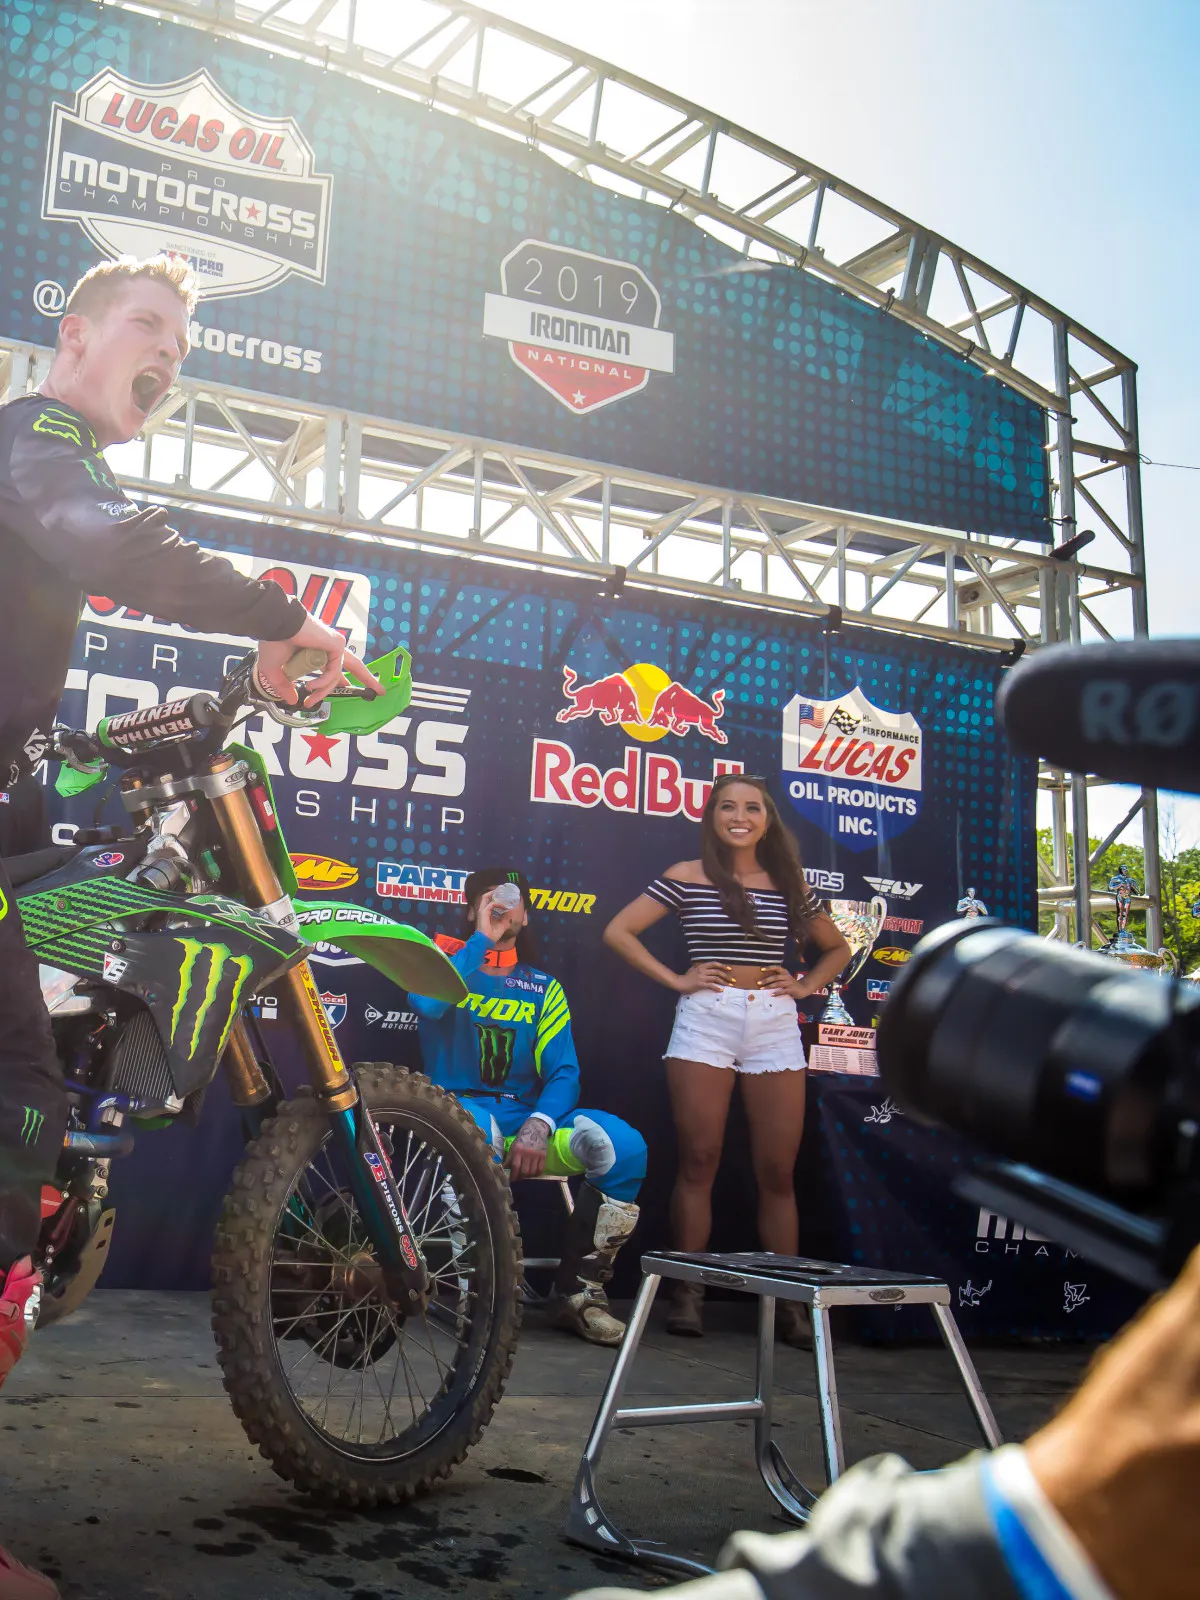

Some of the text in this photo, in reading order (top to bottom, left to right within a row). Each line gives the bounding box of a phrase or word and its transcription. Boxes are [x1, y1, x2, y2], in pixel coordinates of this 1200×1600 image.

[101, 92, 285, 170] LUCAS OIL
[161, 162, 226, 188] PRO
[60, 151, 316, 239] MOTOCROSS
[59, 181, 314, 251] CHAMPIONSHIP
[524, 257, 638, 314] 2019
[530, 311, 630, 356] IRONMAN
[527, 350, 632, 379] NATIONAL
[862, 726, 919, 744] PERFORMANCE
[798, 732, 916, 783] LUCAS
[530, 737, 642, 814] Red
[790, 780, 917, 815] OIL PRODUCTS
[838, 815, 878, 836] INC.
[379, 863, 475, 890] PART
[863, 876, 923, 897] FLY
[297, 908, 332, 924] PRO
[529, 888, 597, 914] THOR
[307, 987, 340, 1062] SHOWA
[457, 992, 536, 1024] THOR
[822, 1027, 876, 1039] GARY JONES
[364, 1152, 405, 1234] JE PISTONS
